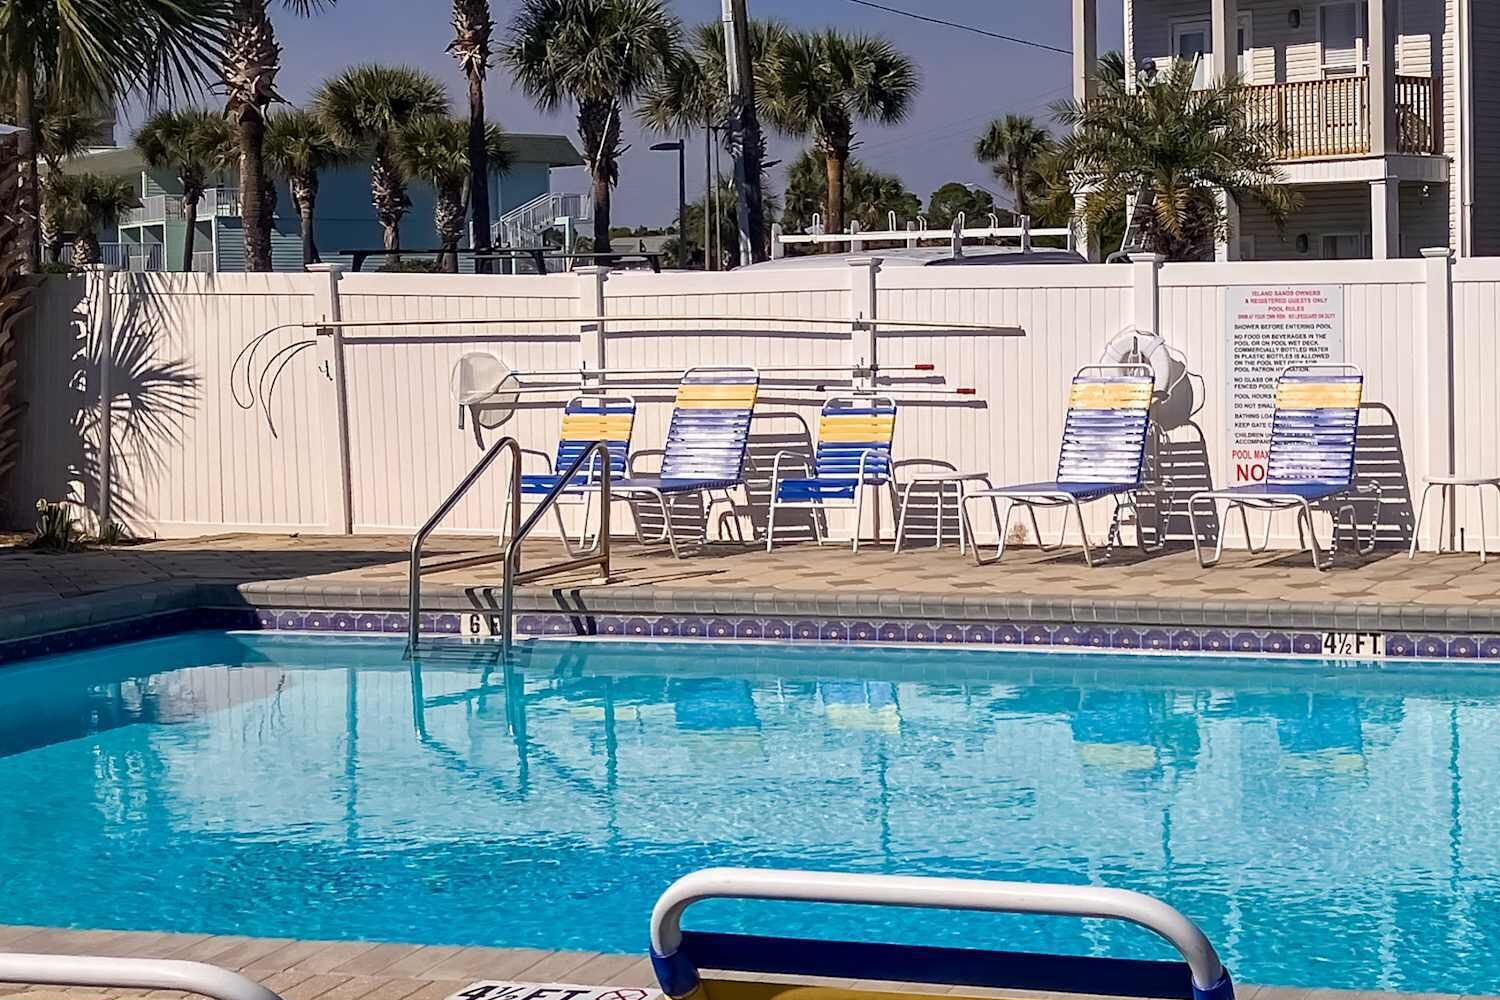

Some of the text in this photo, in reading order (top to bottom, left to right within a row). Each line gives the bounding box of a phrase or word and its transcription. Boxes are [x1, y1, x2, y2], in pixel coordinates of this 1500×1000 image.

[1232, 450, 1252, 460] POOL
[1236, 464, 1265, 482] NO
[470, 614, 480, 634] 6
[1356, 633, 1381, 655] FT.
